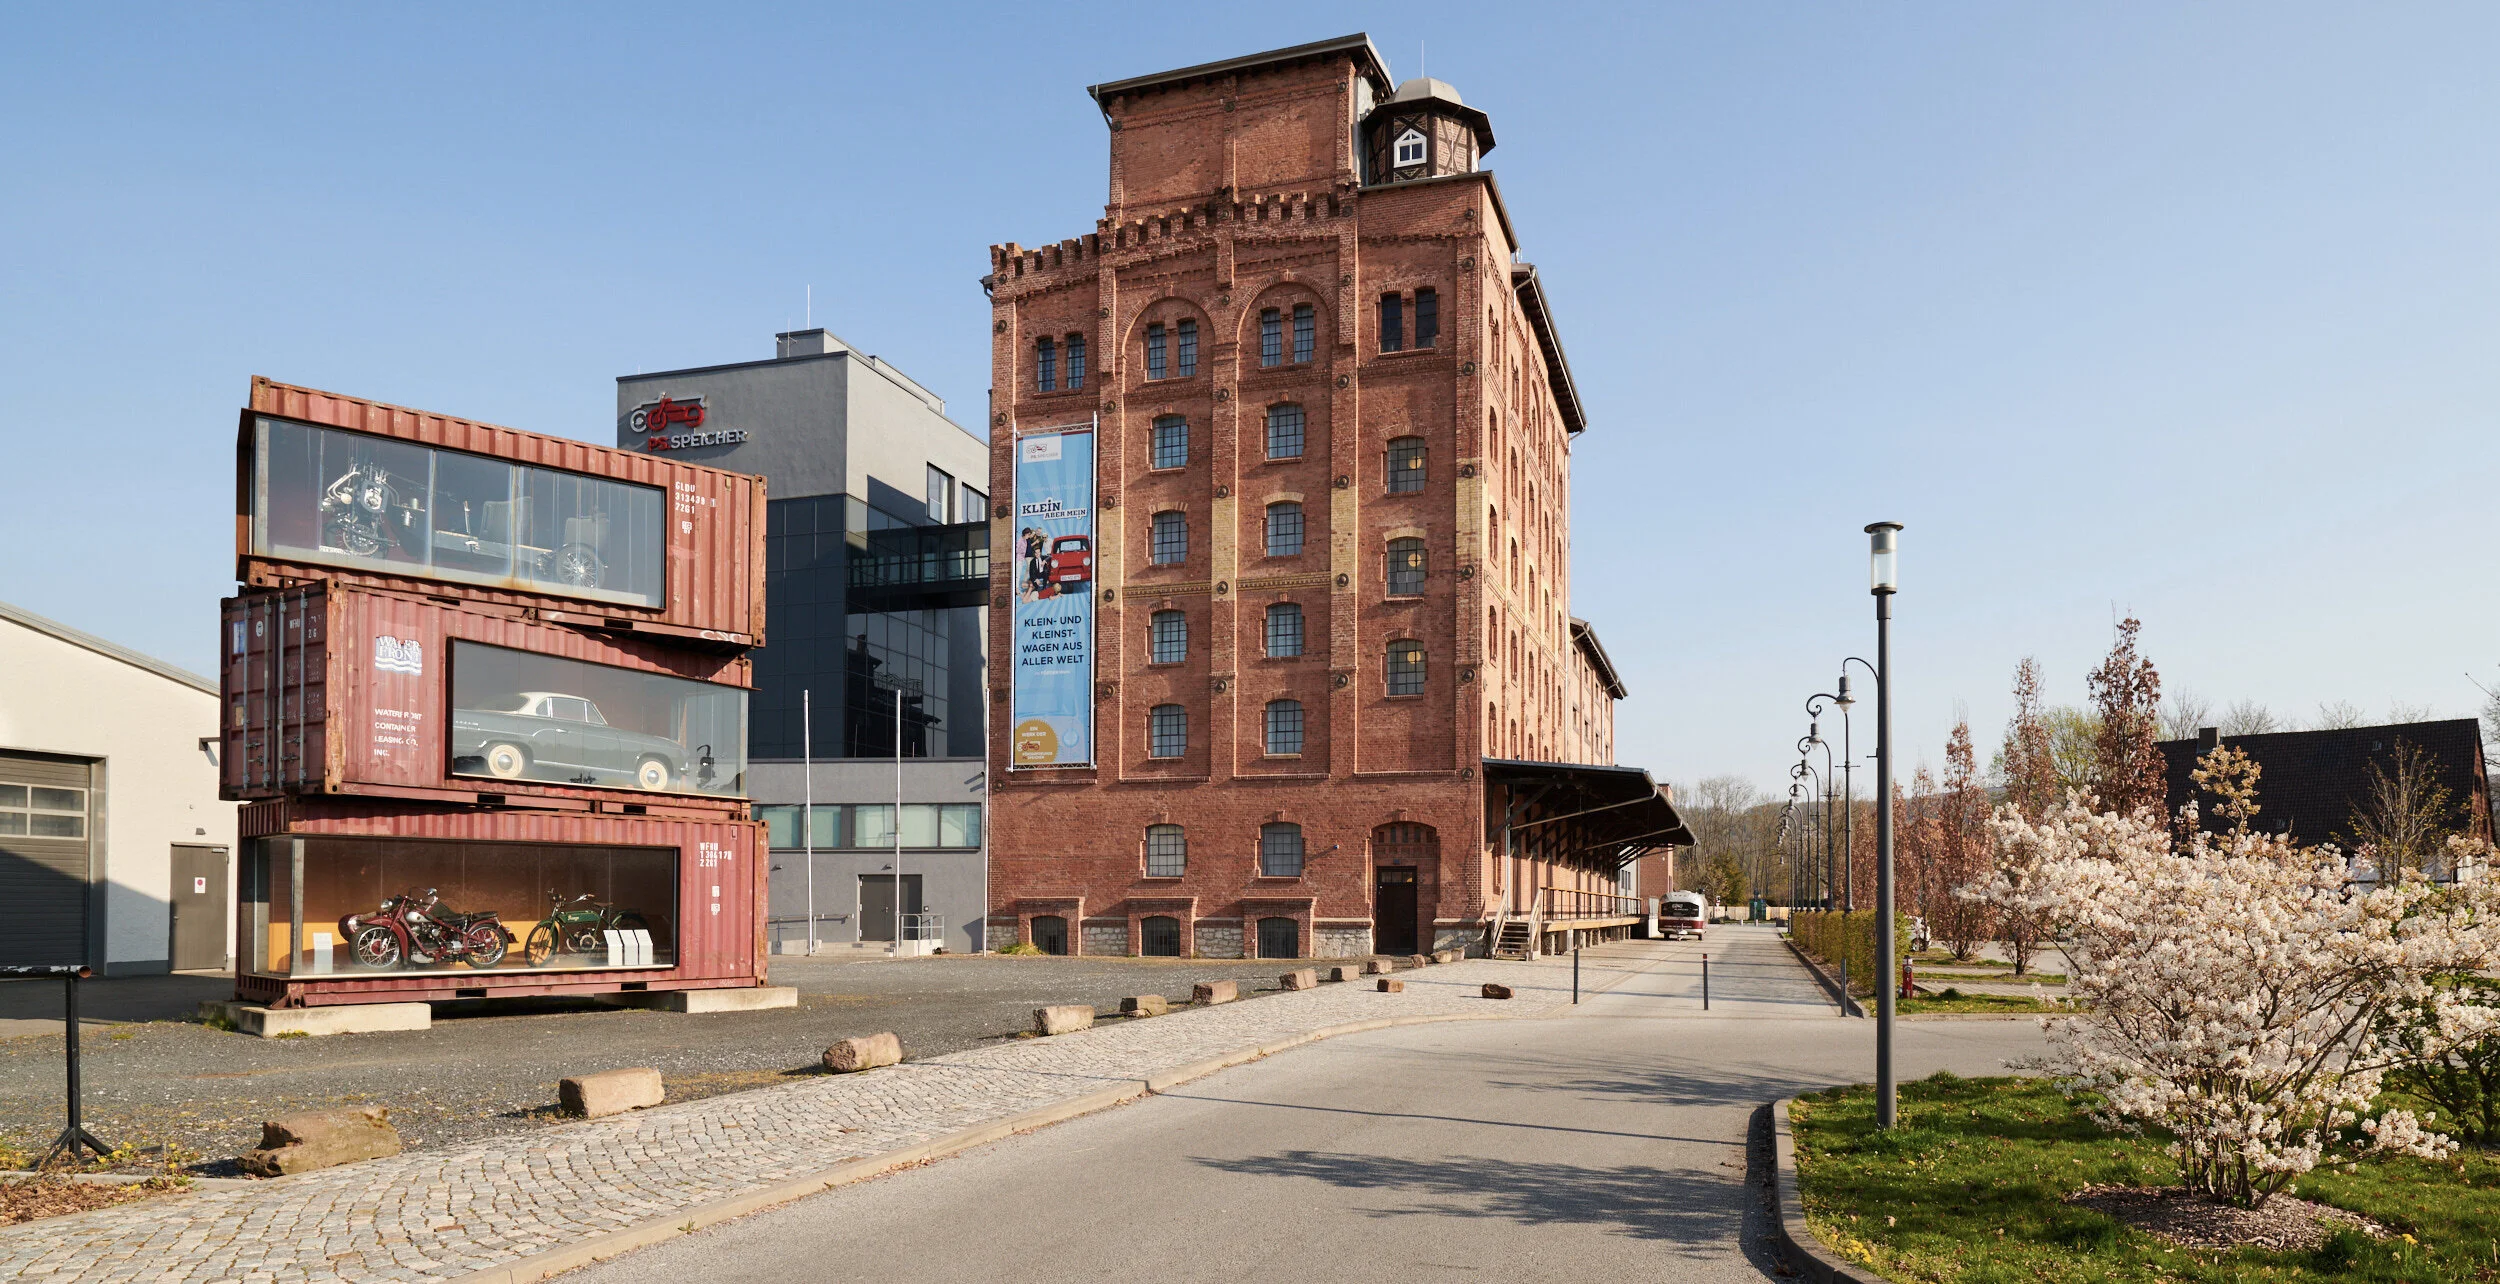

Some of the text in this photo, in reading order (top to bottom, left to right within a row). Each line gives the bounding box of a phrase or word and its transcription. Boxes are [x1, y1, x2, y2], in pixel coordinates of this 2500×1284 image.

[648, 430, 747, 451] PS.SPEICHER
[675, 481, 696, 493] GLDU
[1045, 509, 1086, 519] ABER MEIN
[1024, 615, 1082, 627] KLEIN- UND
[1032, 629, 1076, 639] KLEINST-
[1022, 641, 1083, 653] WAGEN AUS
[1022, 655, 1084, 666] ALLER WELT
[374, 721, 416, 733] CONTAINER
[374, 748, 390, 757] INC.
